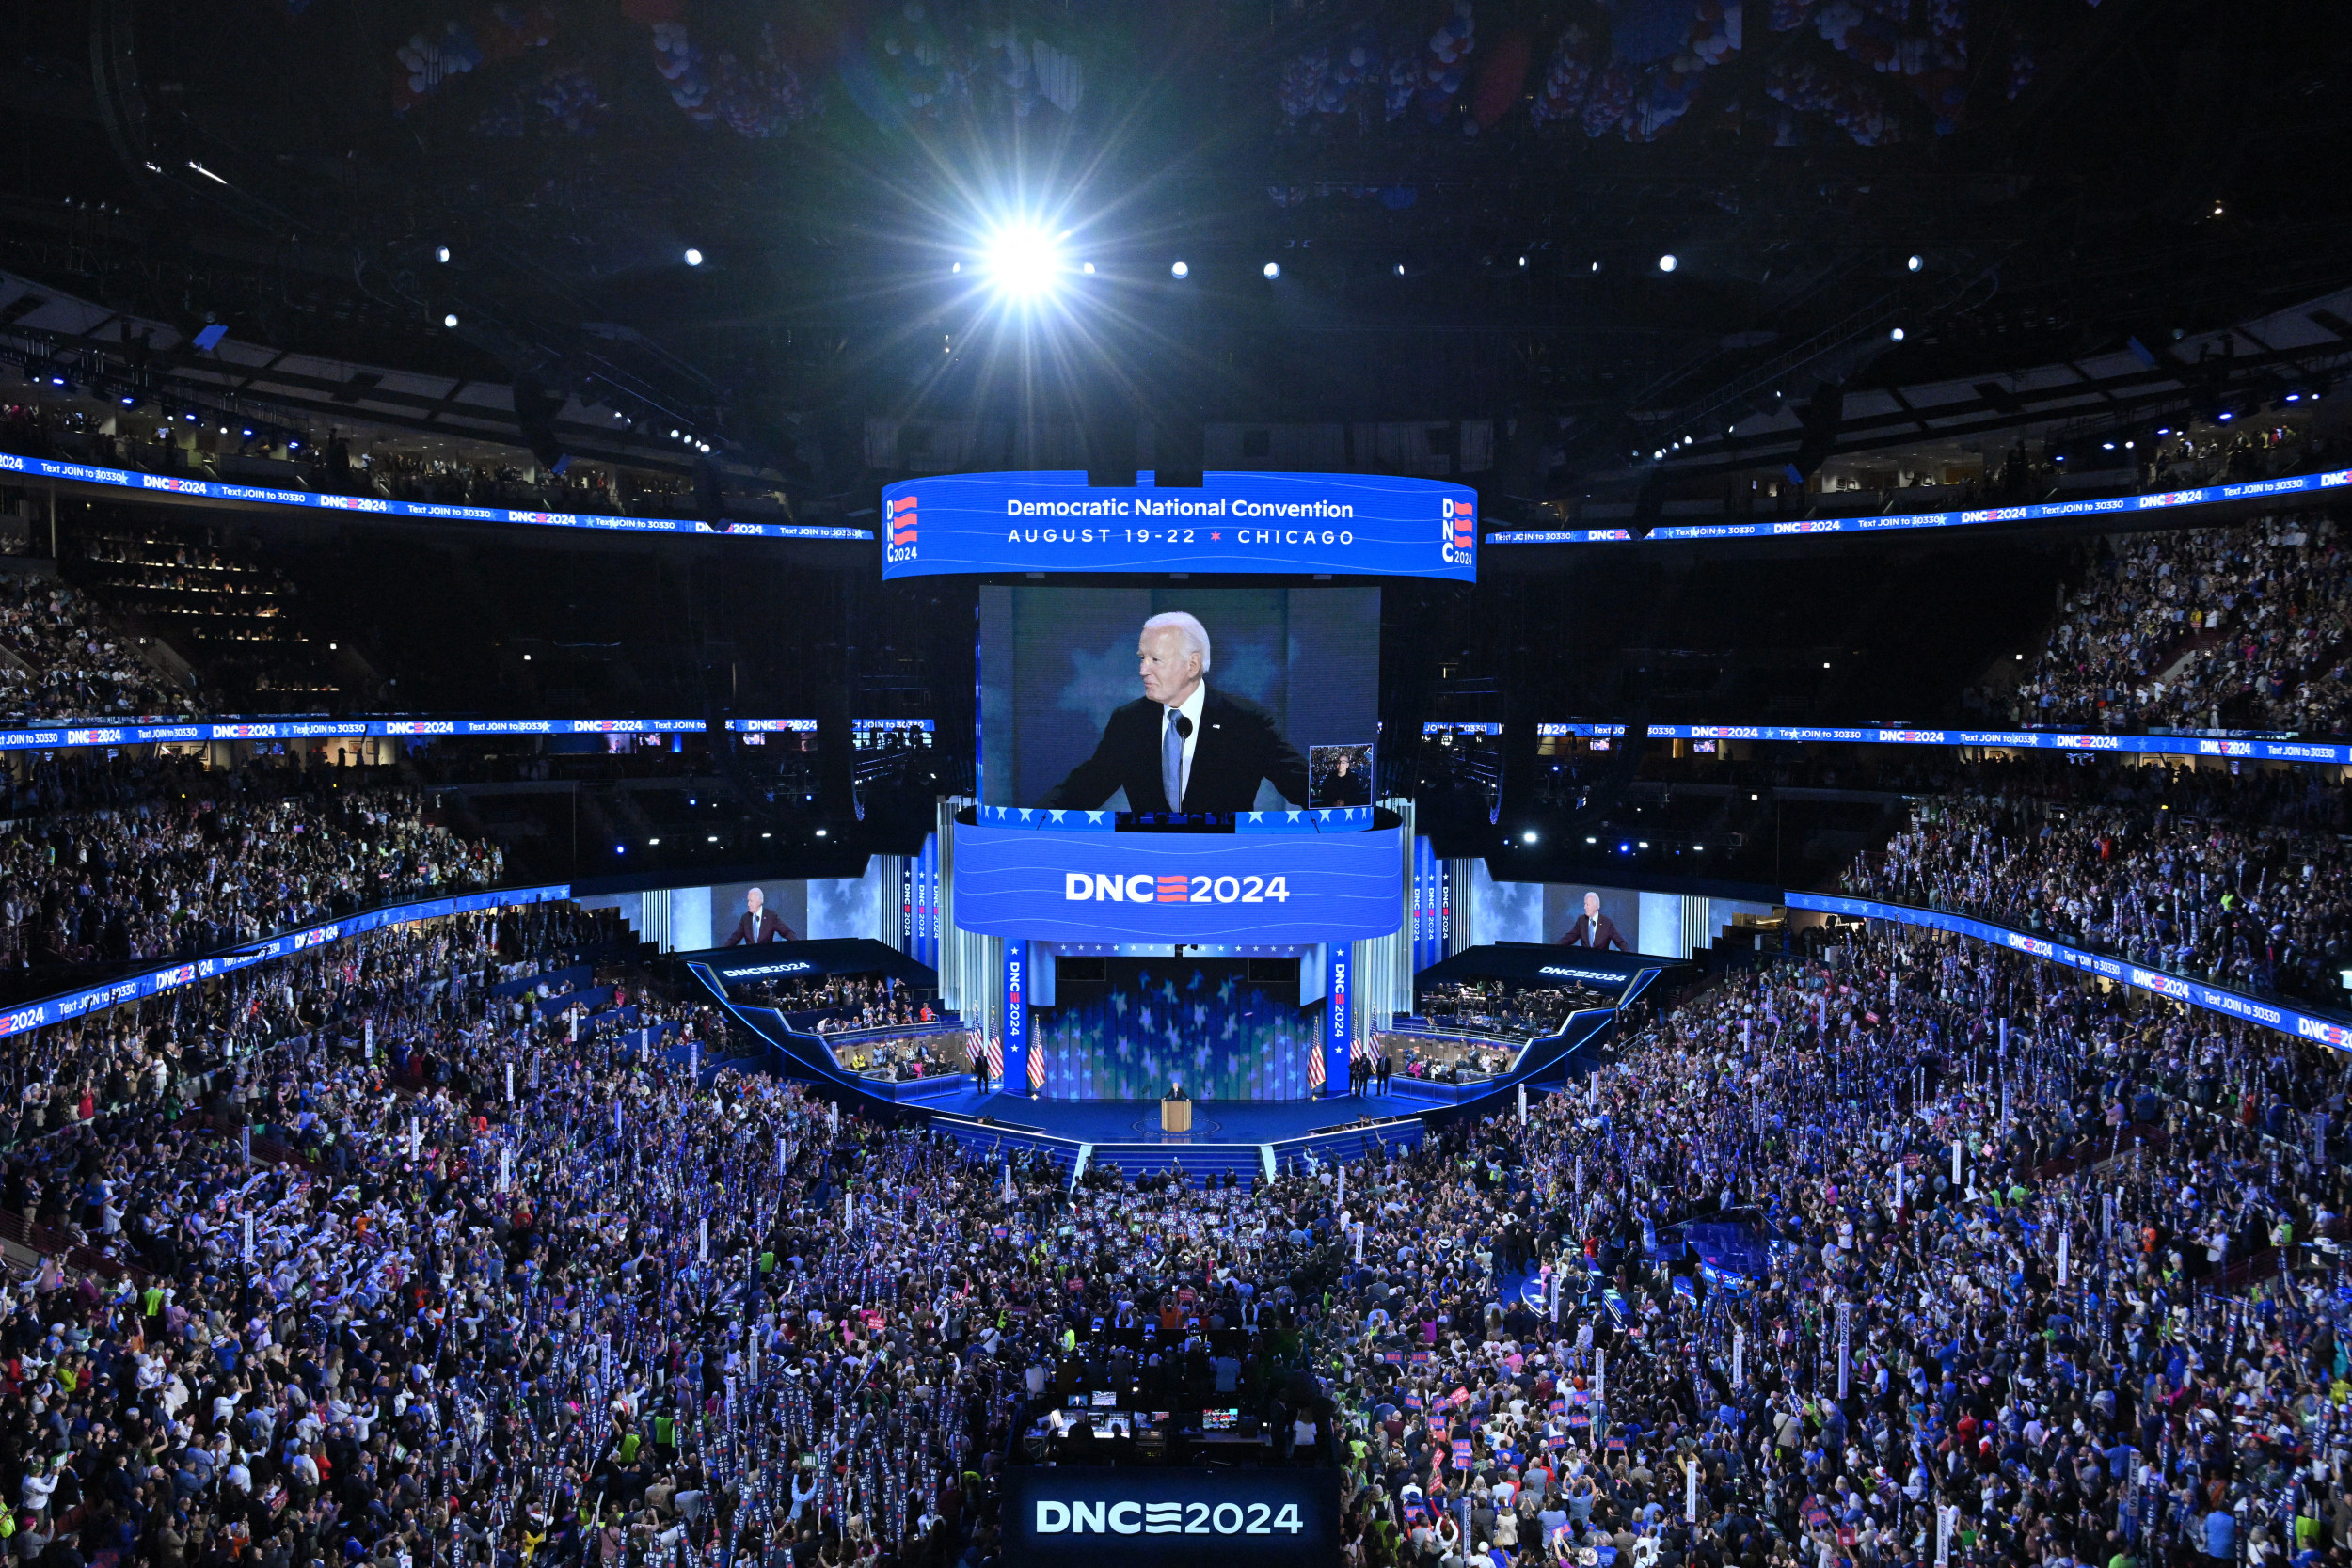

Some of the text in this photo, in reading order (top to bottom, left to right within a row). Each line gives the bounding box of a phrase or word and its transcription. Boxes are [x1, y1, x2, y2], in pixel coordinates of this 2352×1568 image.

[41, 463, 121, 482] Text JOIN to 30330
[2224, 479, 2303, 497] Text JOIN to 30330
[222, 487, 241, 496] Text
[243, 489, 264, 498] JOIN
[278, 493, 305, 502] 30330
[408, 505, 426, 514] Text
[463, 509, 490, 517] 30330
[1008, 498, 1353, 518] Democratic National Convention
[2042, 500, 2123, 515] Text JOIN to 30330
[647, 521, 675, 530] 30330
[1858, 516, 1939, 528] Text JOIN to 30330
[1728, 526, 1755, 534] 30330
[1008, 529, 1353, 545] AUGUST 19-22 CHICAGO
[894, 546, 917, 562] 2024
[1454, 550, 1472, 565] 2024
[138, 729, 151, 739] Text
[152, 729, 167, 737] JOIN
[310, 724, 326, 733] JOIN
[338, 724, 365, 733] 30330
[1822, 730, 1831, 738] to
[6, 733, 57, 744] JOIN to 30330
[1961, 734, 1978, 742] Text
[1979, 734, 2001, 742] JOIN
[58, 1000, 77, 1014] Text
[101, 990, 110, 1003] to
[2204, 990, 2280, 1023] Text JOIN to 30330
[1406, 1398, 1422, 1407] USA
[1429, 1418, 1445, 1427] USA
[1571, 1417, 1589, 1425] USA
[1454, 1441, 1470, 1450] USA
[1608, 1439, 1624, 1448] USA
[802, 1456, 817, 1466] JILL
[2130, 1458, 2138, 1508] TEXAS
